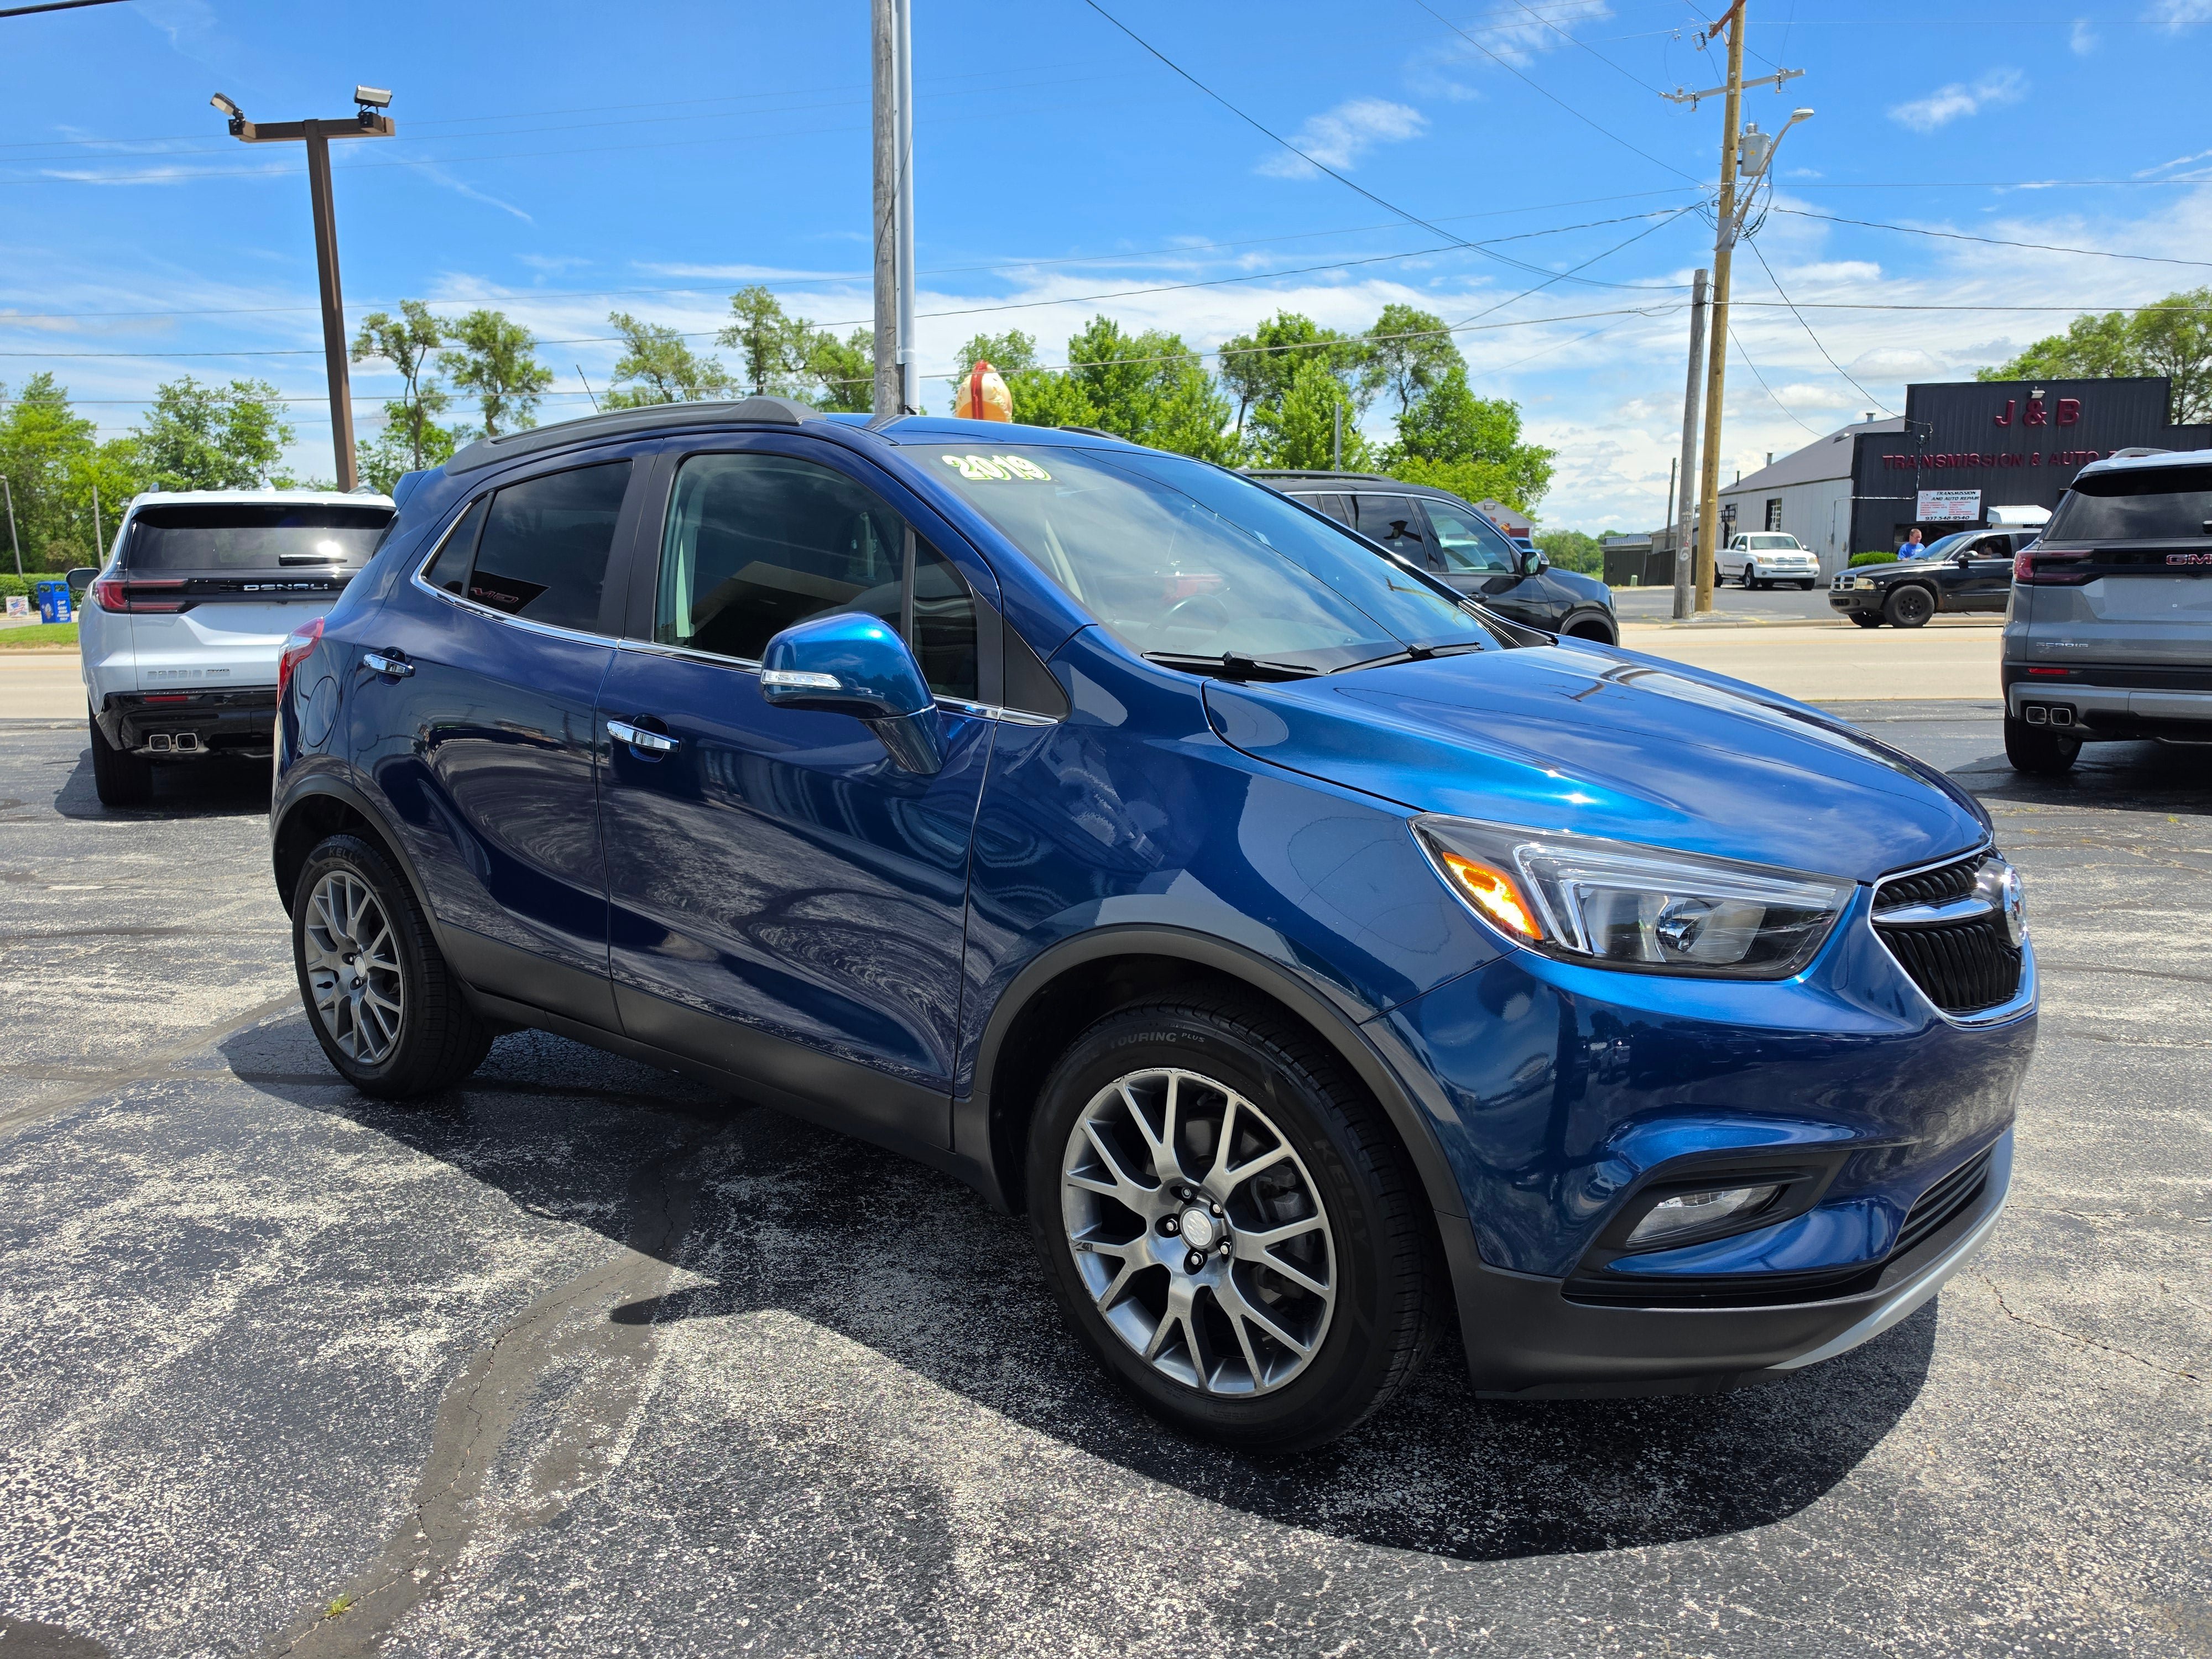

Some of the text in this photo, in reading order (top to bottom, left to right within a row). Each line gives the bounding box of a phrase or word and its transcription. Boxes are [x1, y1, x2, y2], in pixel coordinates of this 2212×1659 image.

[1995, 398, 2081, 427] J & B
[941, 455, 1052, 481] 2019
[1882, 452, 2023, 470] TRANSMISSION
[2030, 452, 2042, 467] &
[2048, 451, 2100, 467] AUTO
[329, 846, 361, 864] KELLY
[1107, 1031, 1206, 1049] TOURING PLUS
